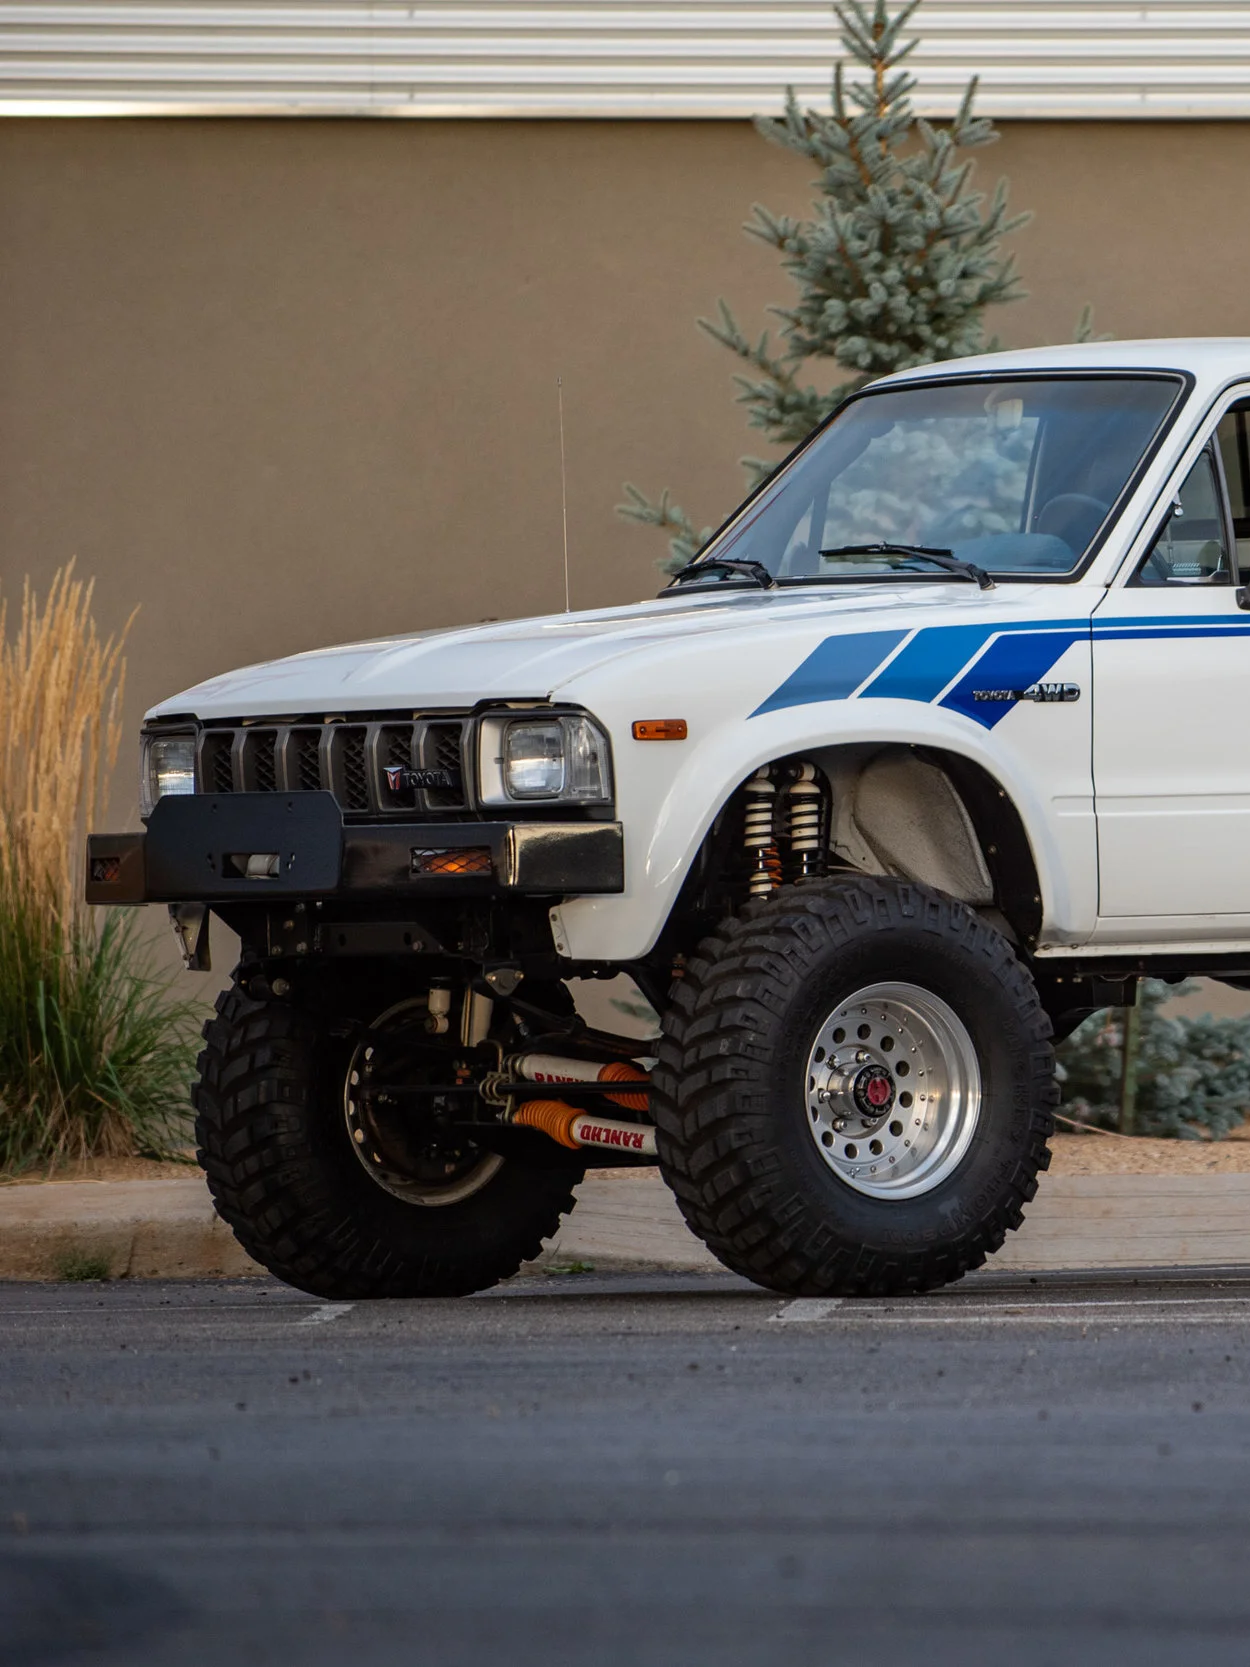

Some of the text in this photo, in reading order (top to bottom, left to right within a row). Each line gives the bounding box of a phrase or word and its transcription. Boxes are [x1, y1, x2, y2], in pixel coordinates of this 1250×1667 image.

[972, 682, 1081, 703] TOYOTA 4WD
[402, 771, 454, 788] TOYOTA
[580, 1124, 645, 1149] RANCHO
